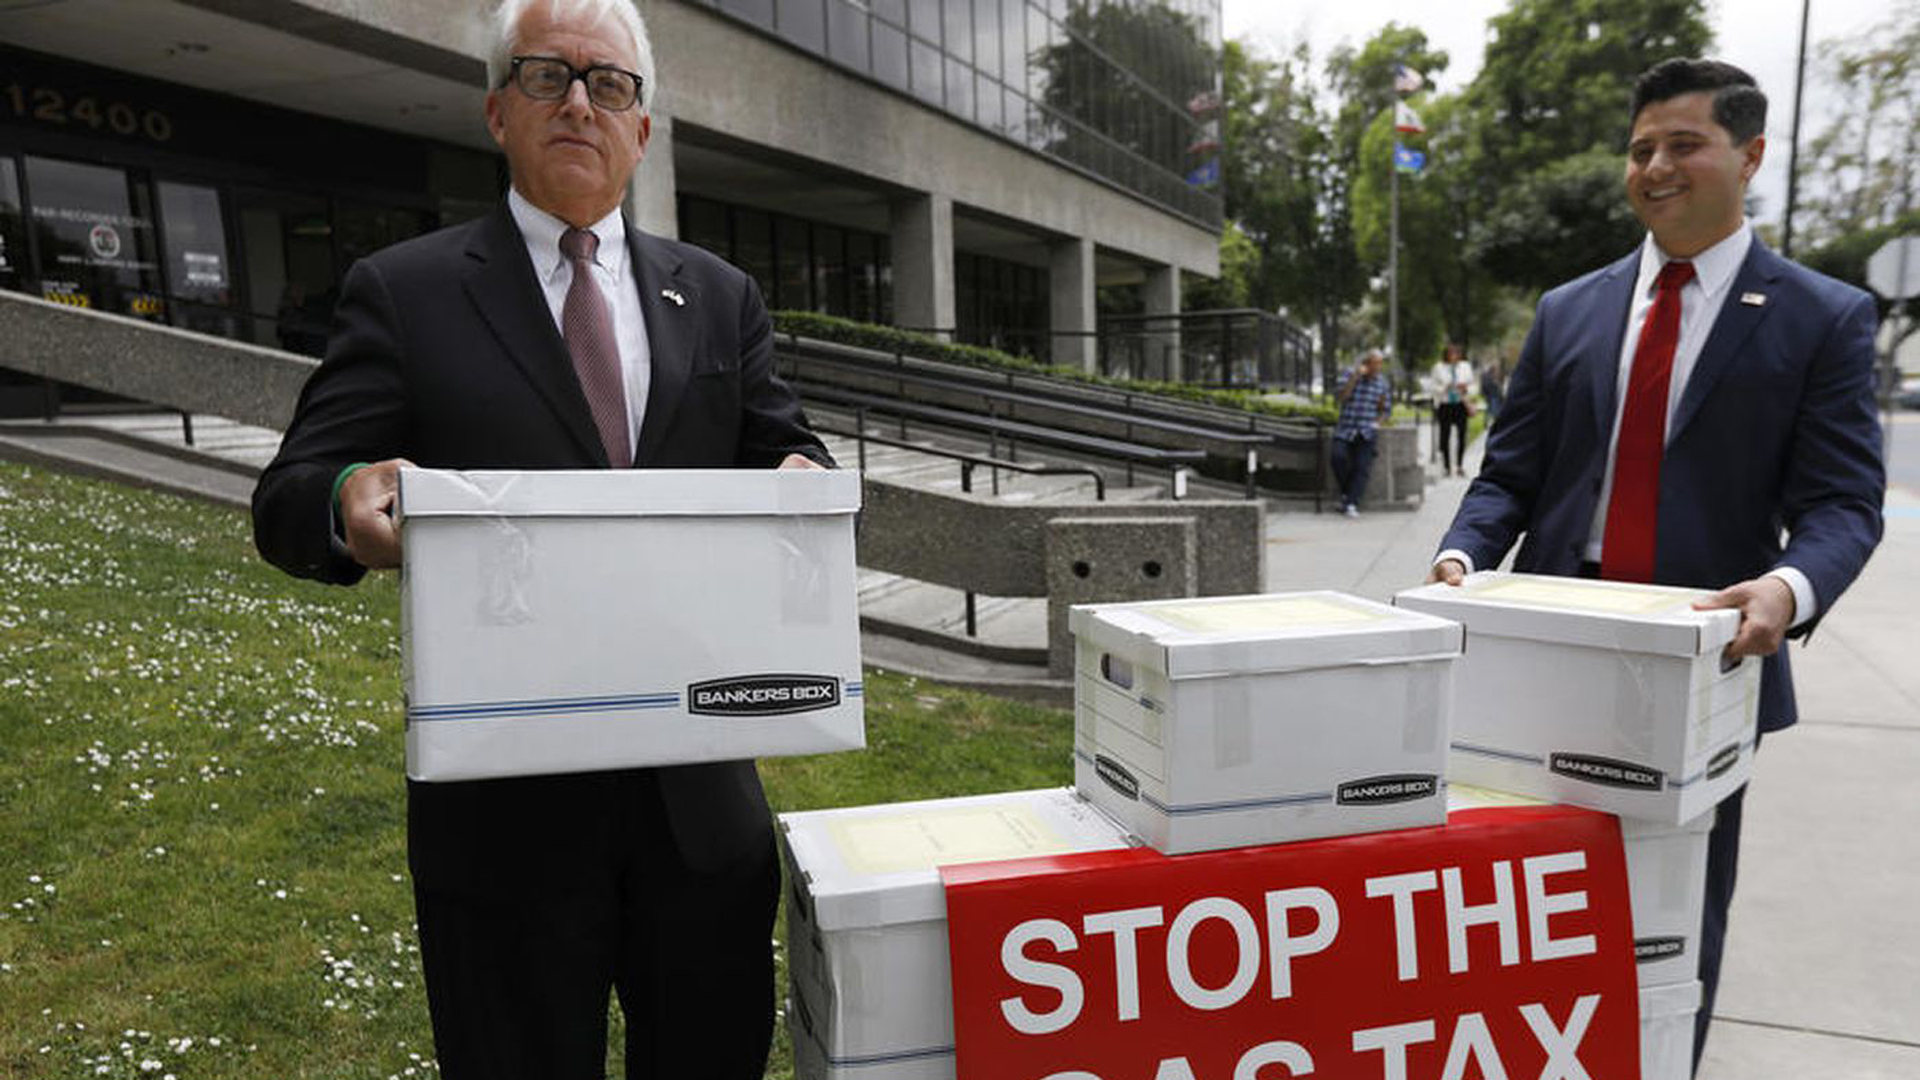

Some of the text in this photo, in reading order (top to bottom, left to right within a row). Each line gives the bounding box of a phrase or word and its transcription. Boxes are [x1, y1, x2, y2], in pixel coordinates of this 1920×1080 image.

[7, 84, 172, 141] 12400
[697, 684, 832, 705] BANKERS BOX
[1343, 781, 1431, 799] BANKERS BOX
[1625, 771, 1657, 785] BOX
[1000, 851, 1597, 1035] STOP THE
[1352, 994, 1601, 1080] TAX
